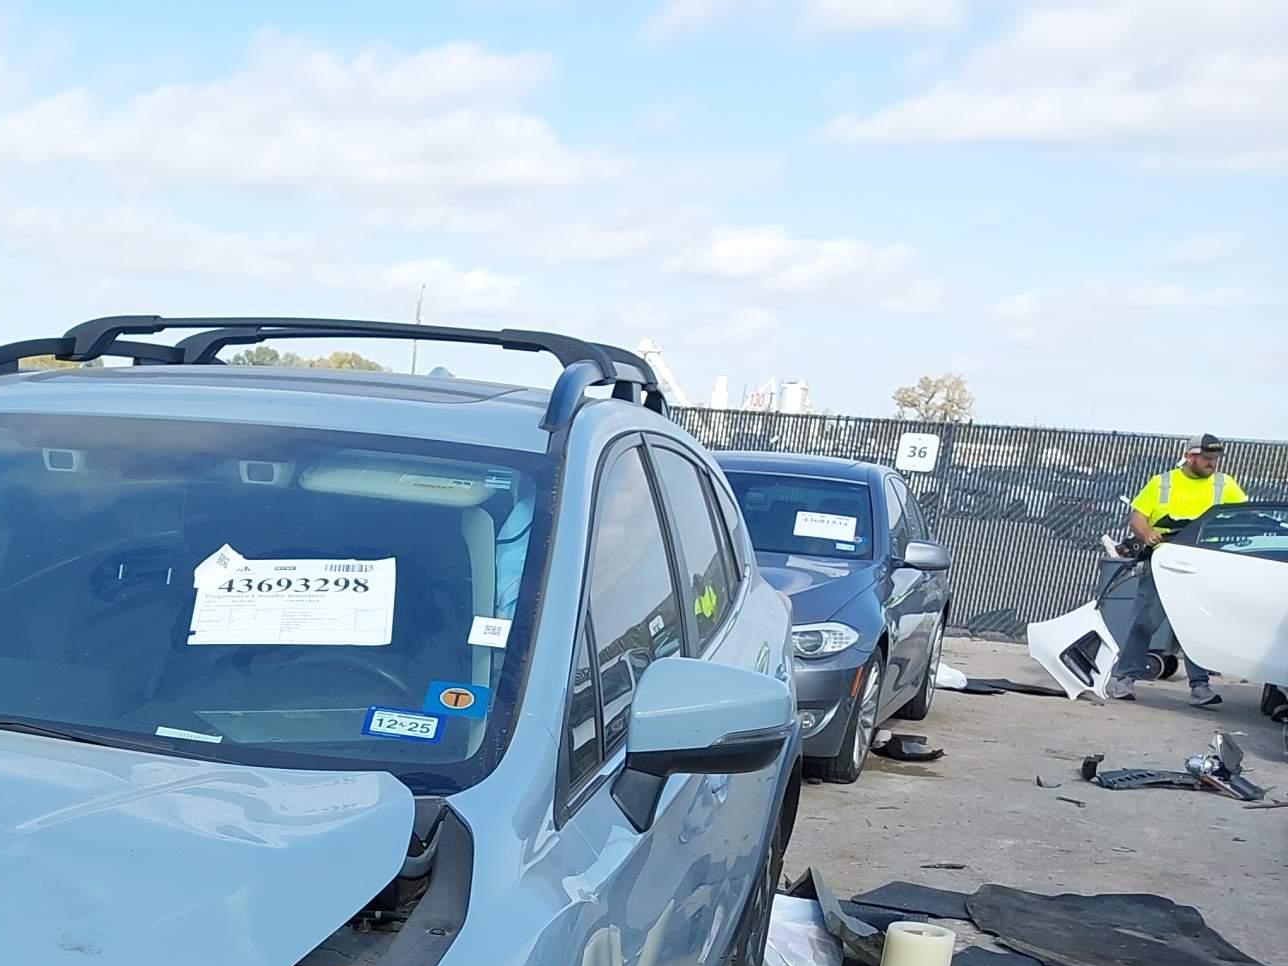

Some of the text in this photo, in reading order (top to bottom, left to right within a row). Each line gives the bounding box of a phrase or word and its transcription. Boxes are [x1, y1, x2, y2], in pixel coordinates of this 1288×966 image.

[907, 445, 928, 459] 36
[218, 576, 370, 594] 43693298
[448, 690, 469, 707] T
[376, 717, 398, 730] 12
[406, 721, 432, 734] 25
